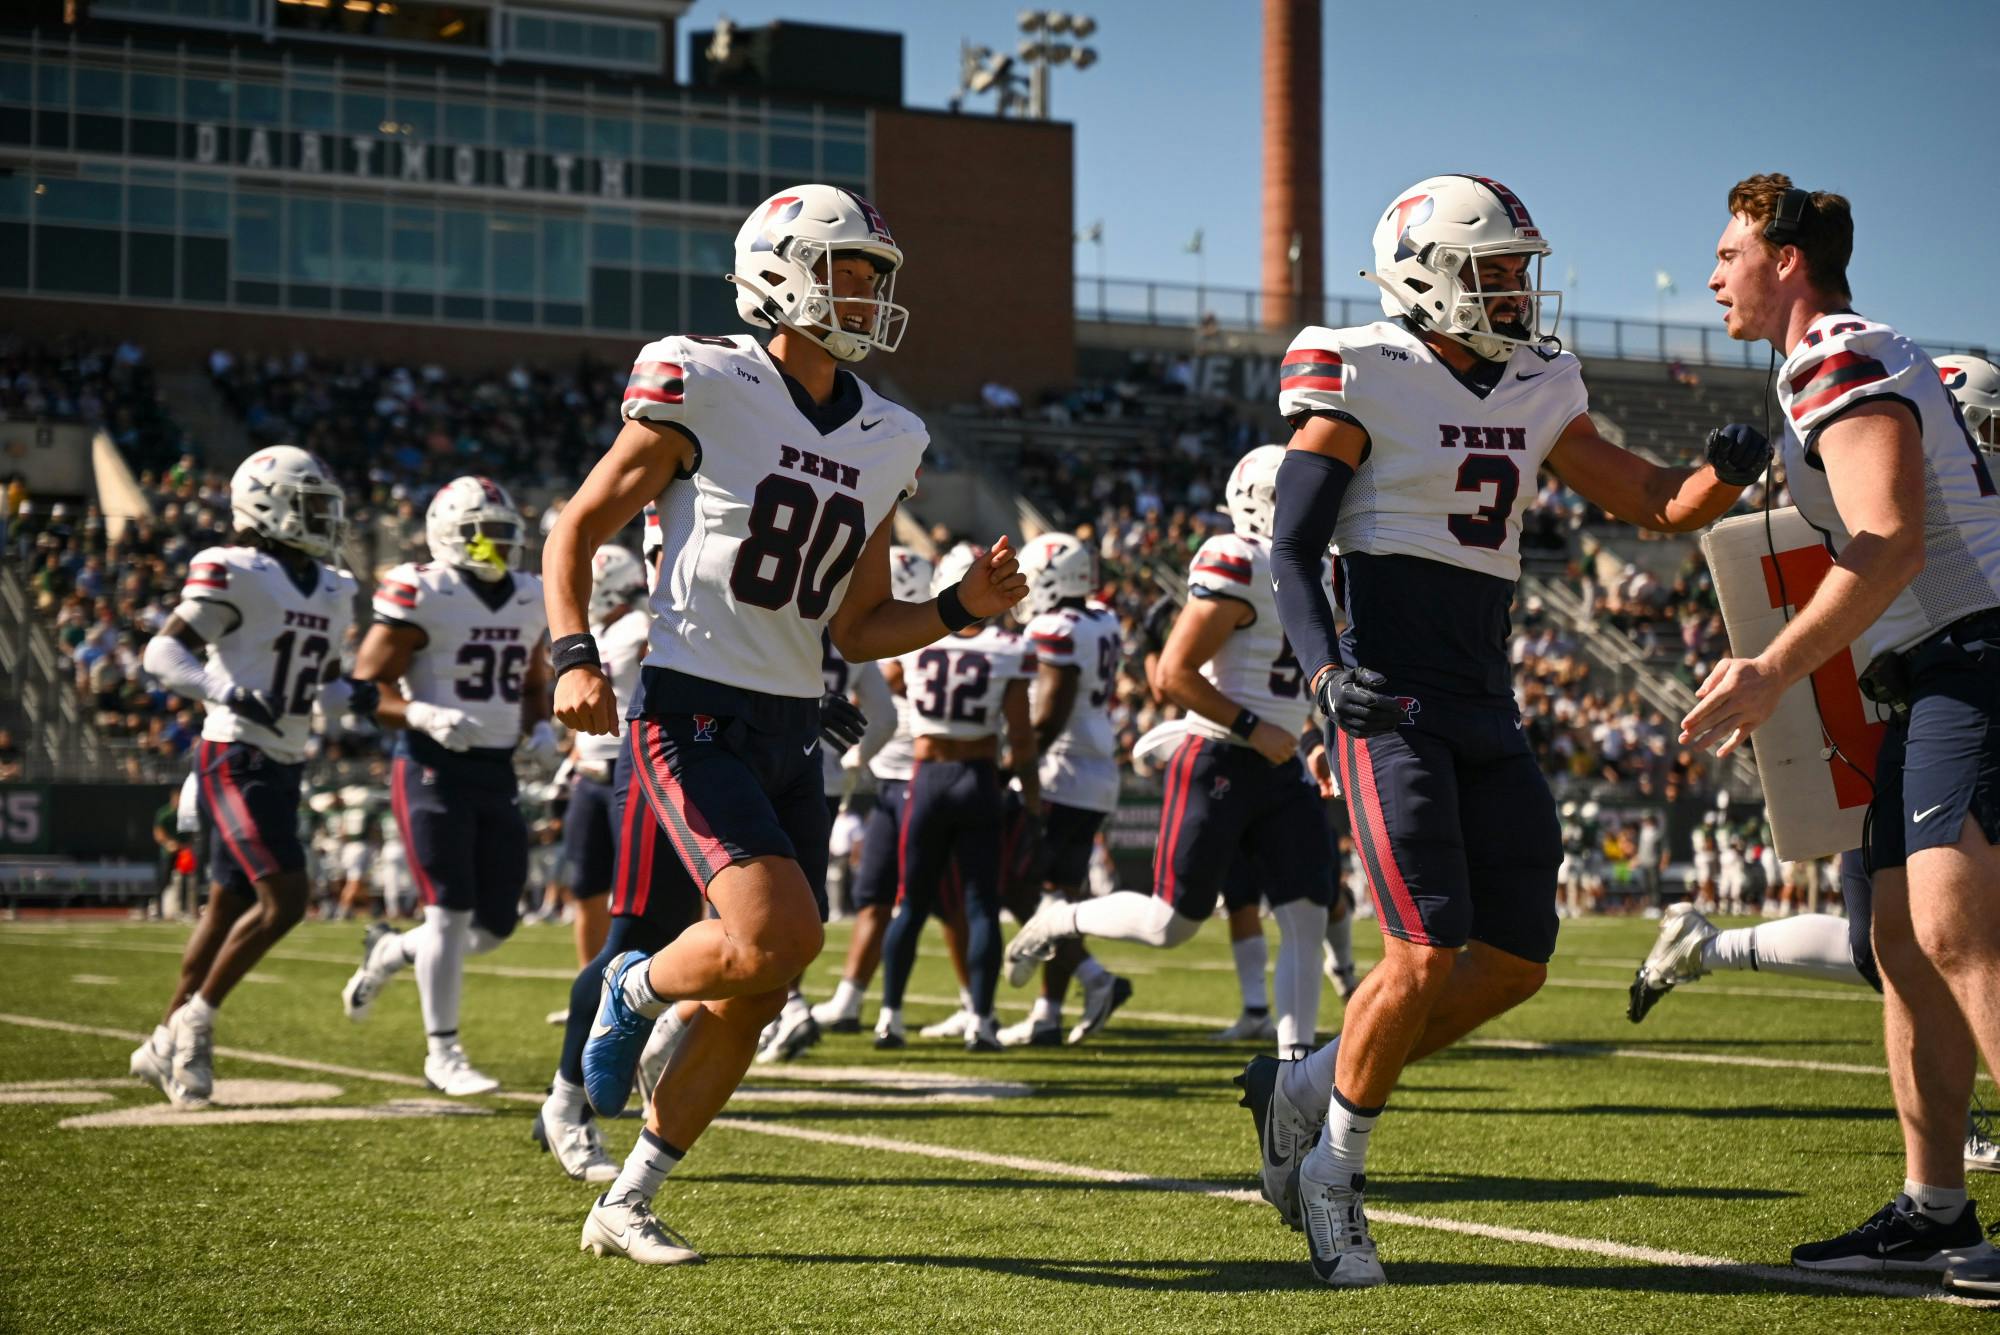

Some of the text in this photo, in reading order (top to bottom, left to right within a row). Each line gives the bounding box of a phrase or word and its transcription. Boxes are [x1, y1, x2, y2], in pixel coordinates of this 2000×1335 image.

[195, 123, 628, 197] DARTMOUTH
[736, 367, 753, 382] Ivy
[1381, 346, 1399, 361] Ivy
[779, 444, 861, 491] PENN
[1439, 424, 1527, 451] PENN
[1447, 453, 1520, 551] 3
[729, 473, 867, 620] 80
[271, 630, 331, 718] 12
[454, 644, 528, 704] 36
[916, 648, 992, 725] 32
[693, 714, 718, 741] P
